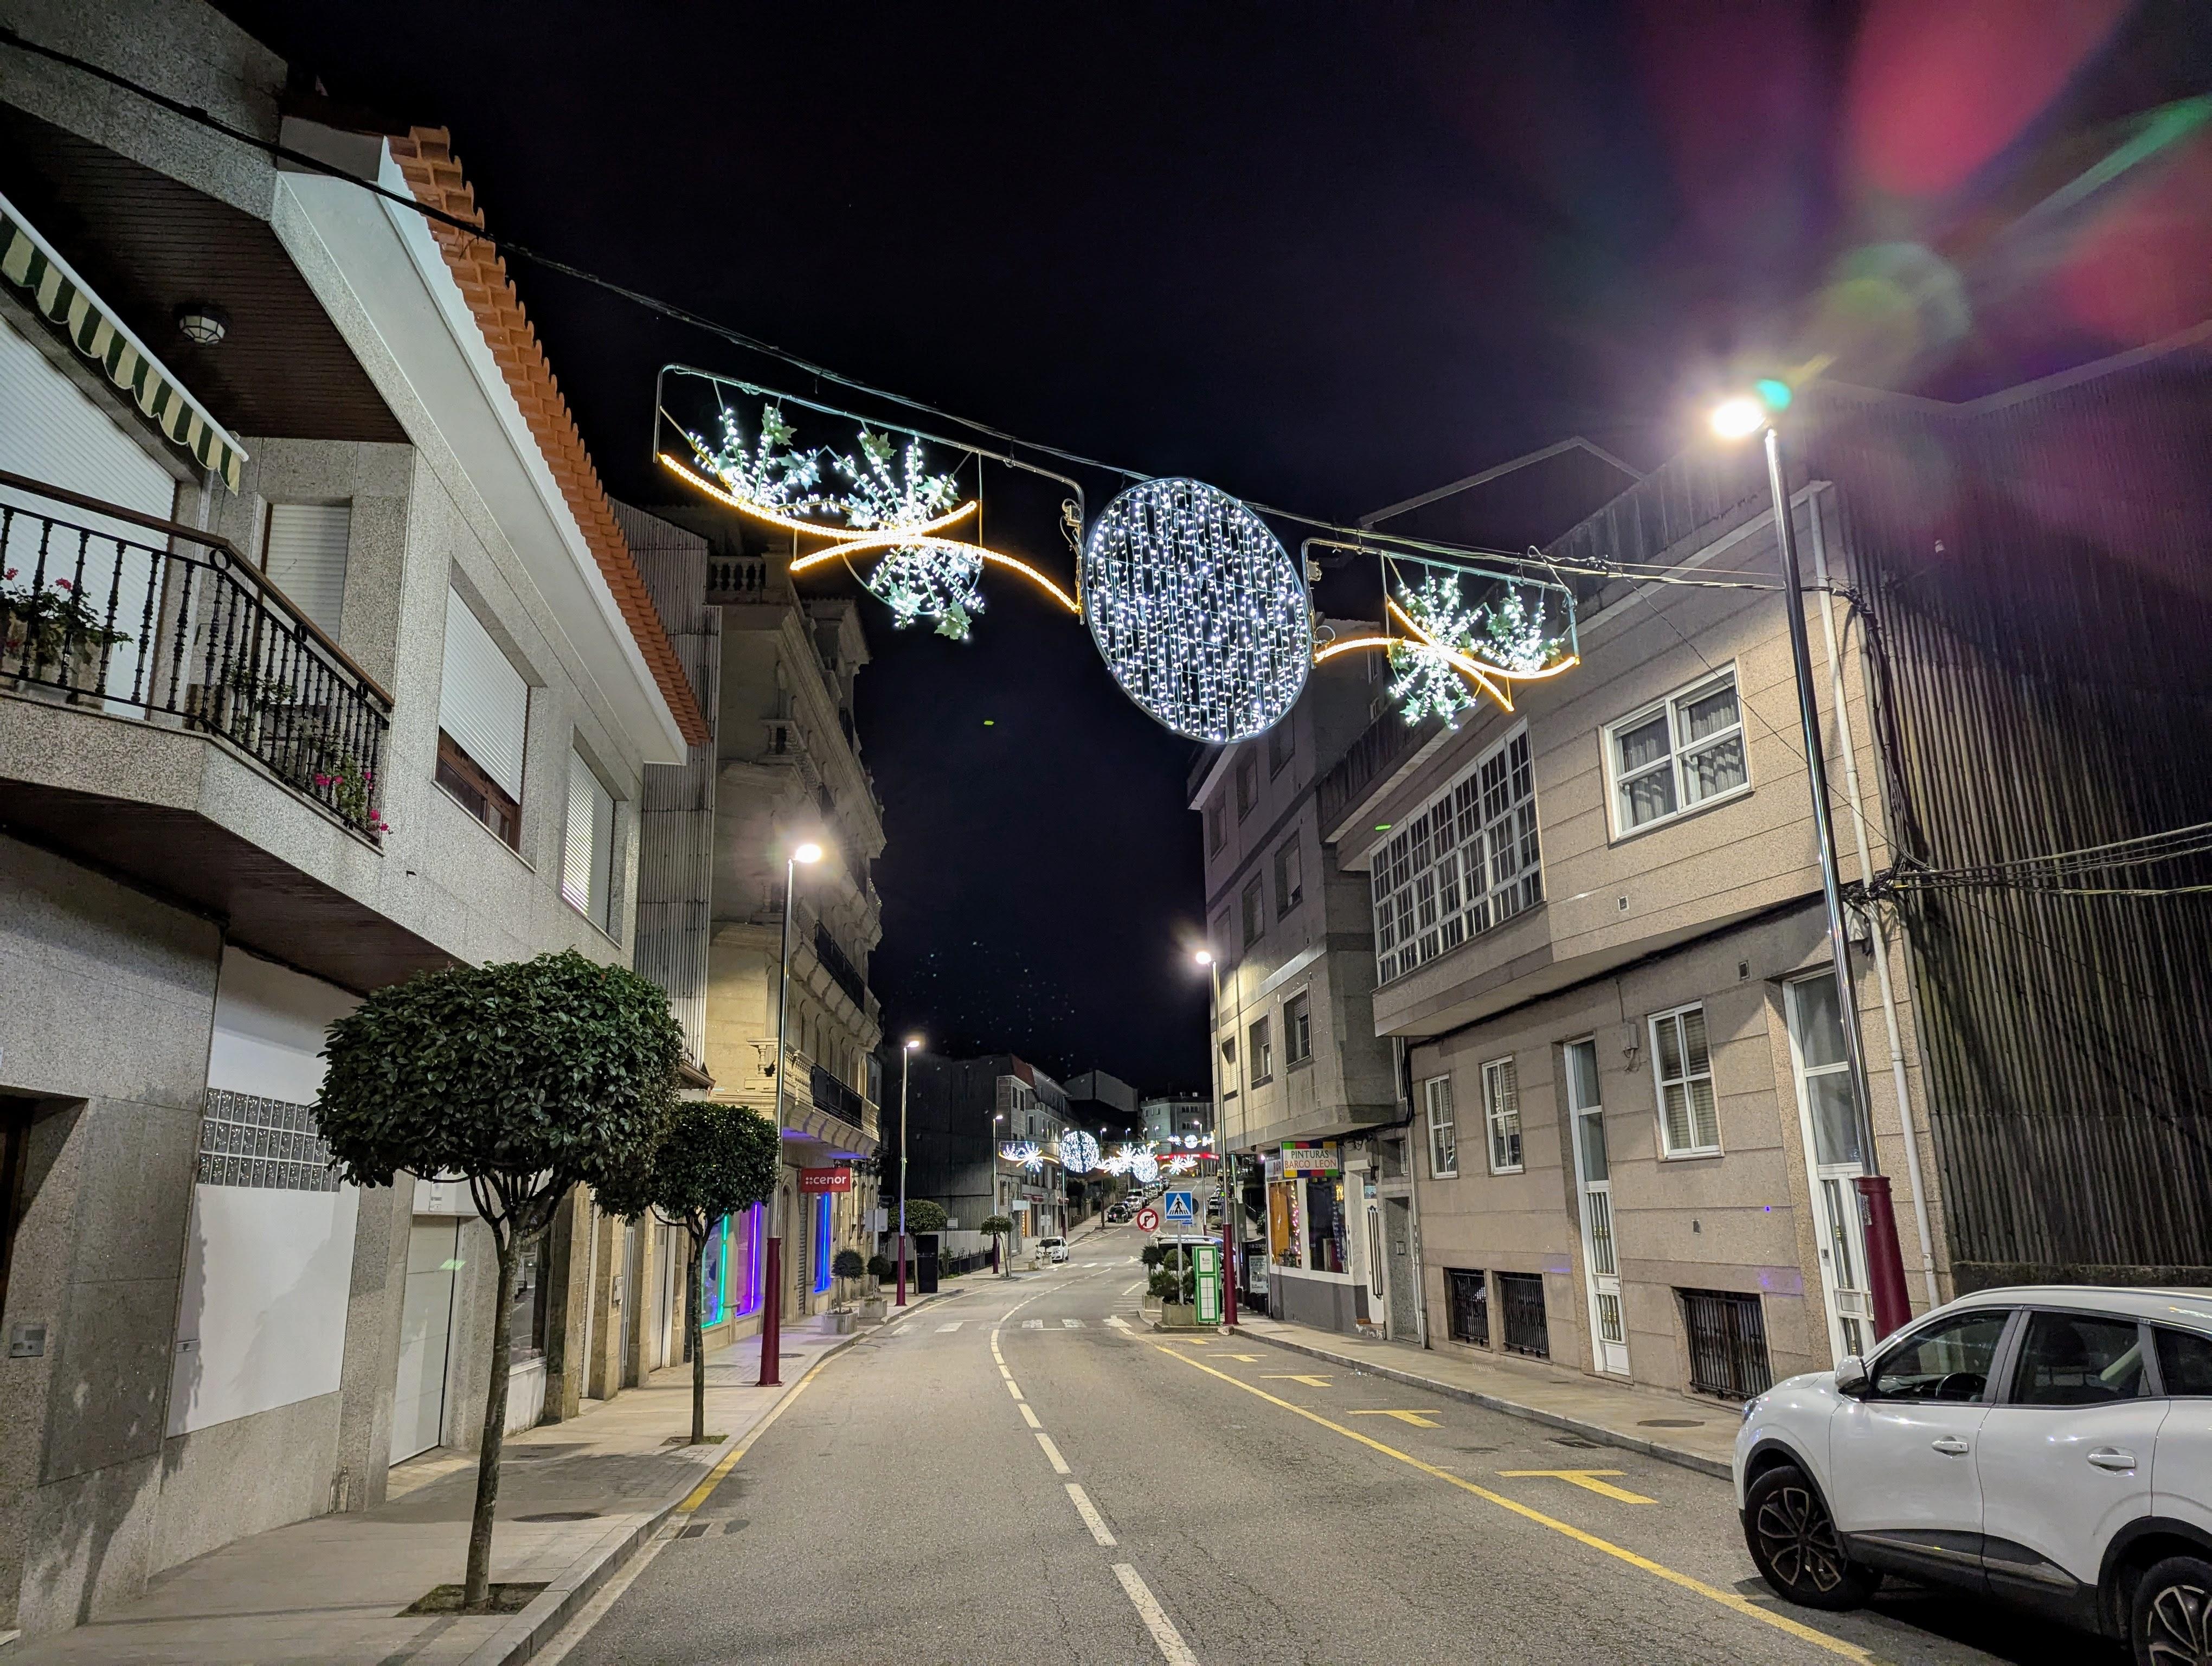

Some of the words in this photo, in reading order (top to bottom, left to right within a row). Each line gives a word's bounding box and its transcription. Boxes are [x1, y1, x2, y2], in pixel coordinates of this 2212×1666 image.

[1291, 1150, 1329, 1159] PINTURAS
[1284, 1160, 1310, 1169] BARCO
[1315, 1159, 1336, 1168] LEON
[813, 1176, 847, 1184] cenor
